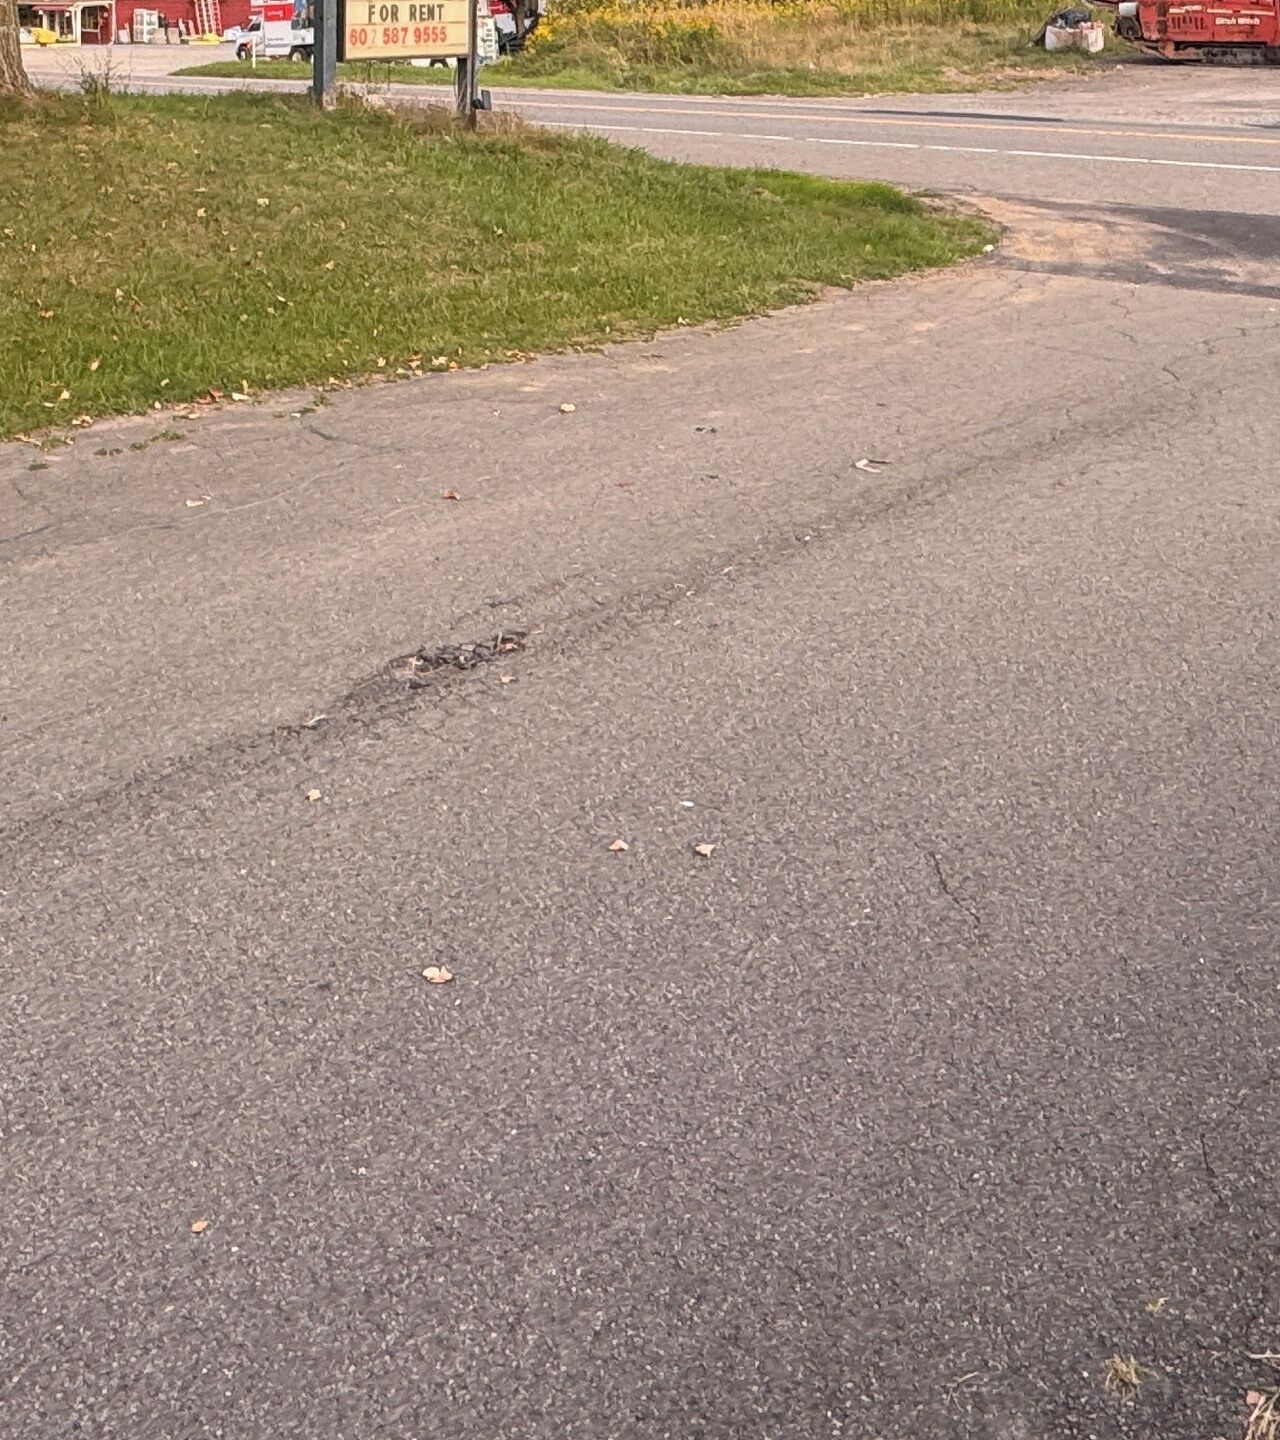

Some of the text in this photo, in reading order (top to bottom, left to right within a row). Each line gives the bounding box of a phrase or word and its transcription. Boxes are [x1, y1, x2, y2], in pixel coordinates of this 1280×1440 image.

[368, 4, 444, 23] FOR RENT
[349, 26, 447, 46] 607 587 9555
